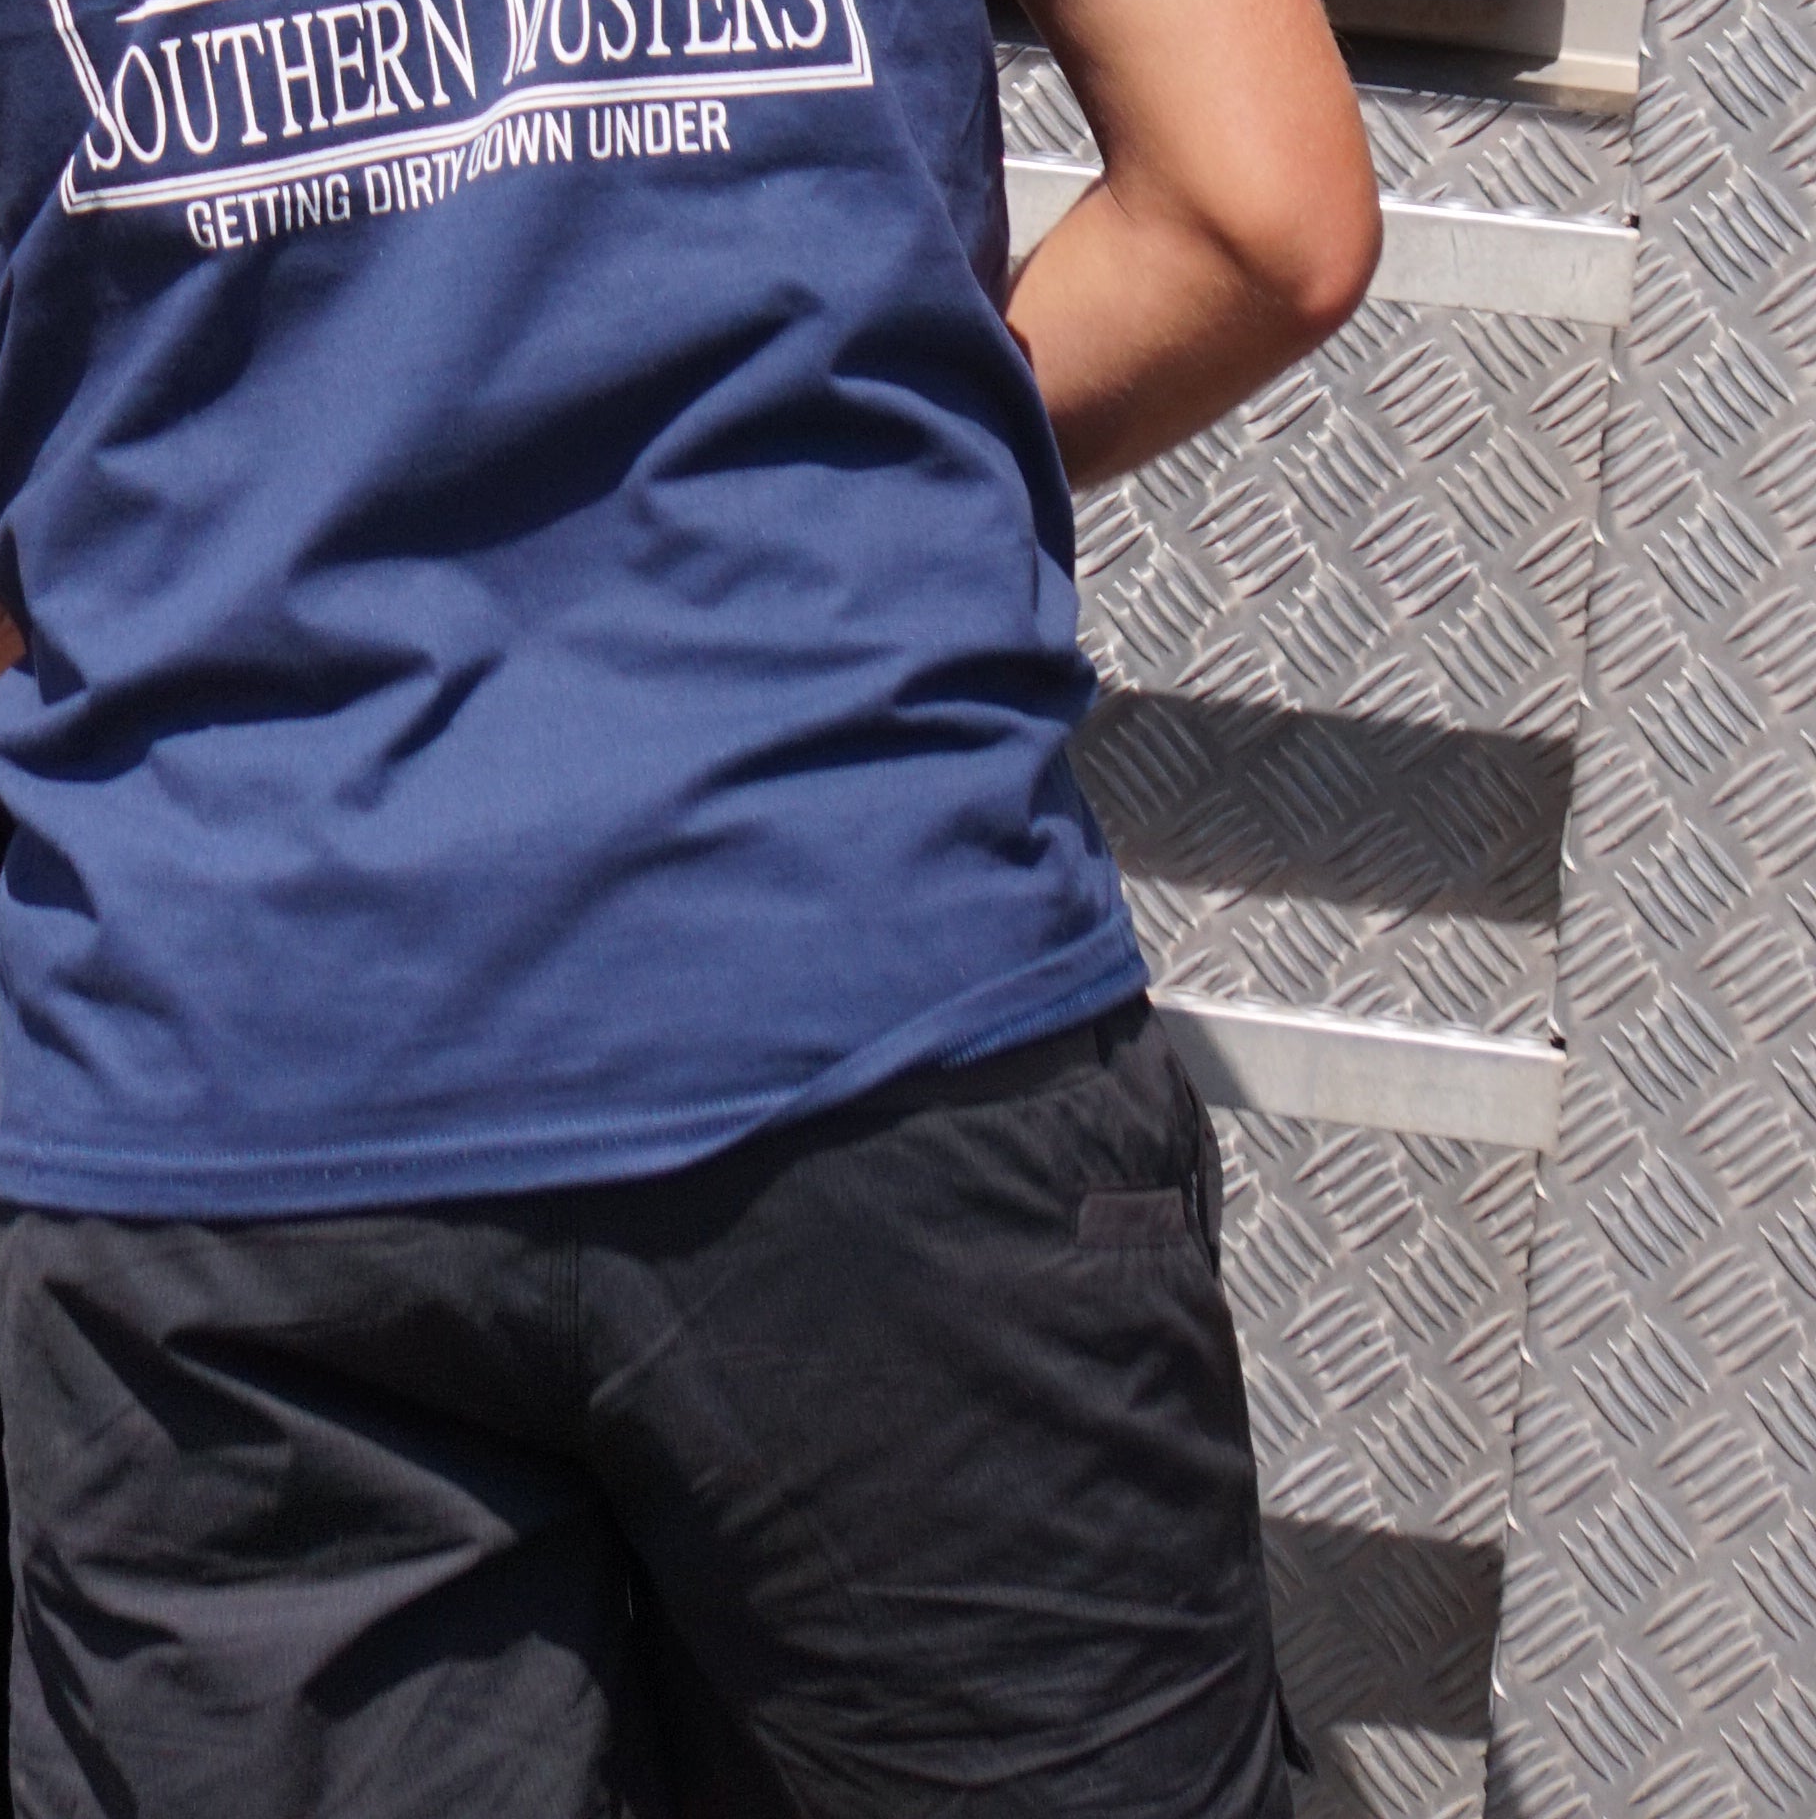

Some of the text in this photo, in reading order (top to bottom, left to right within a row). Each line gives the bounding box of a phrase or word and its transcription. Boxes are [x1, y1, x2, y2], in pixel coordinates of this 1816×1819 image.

[185, 99, 731, 250] GETTING DIRTY DOWN UNDER
